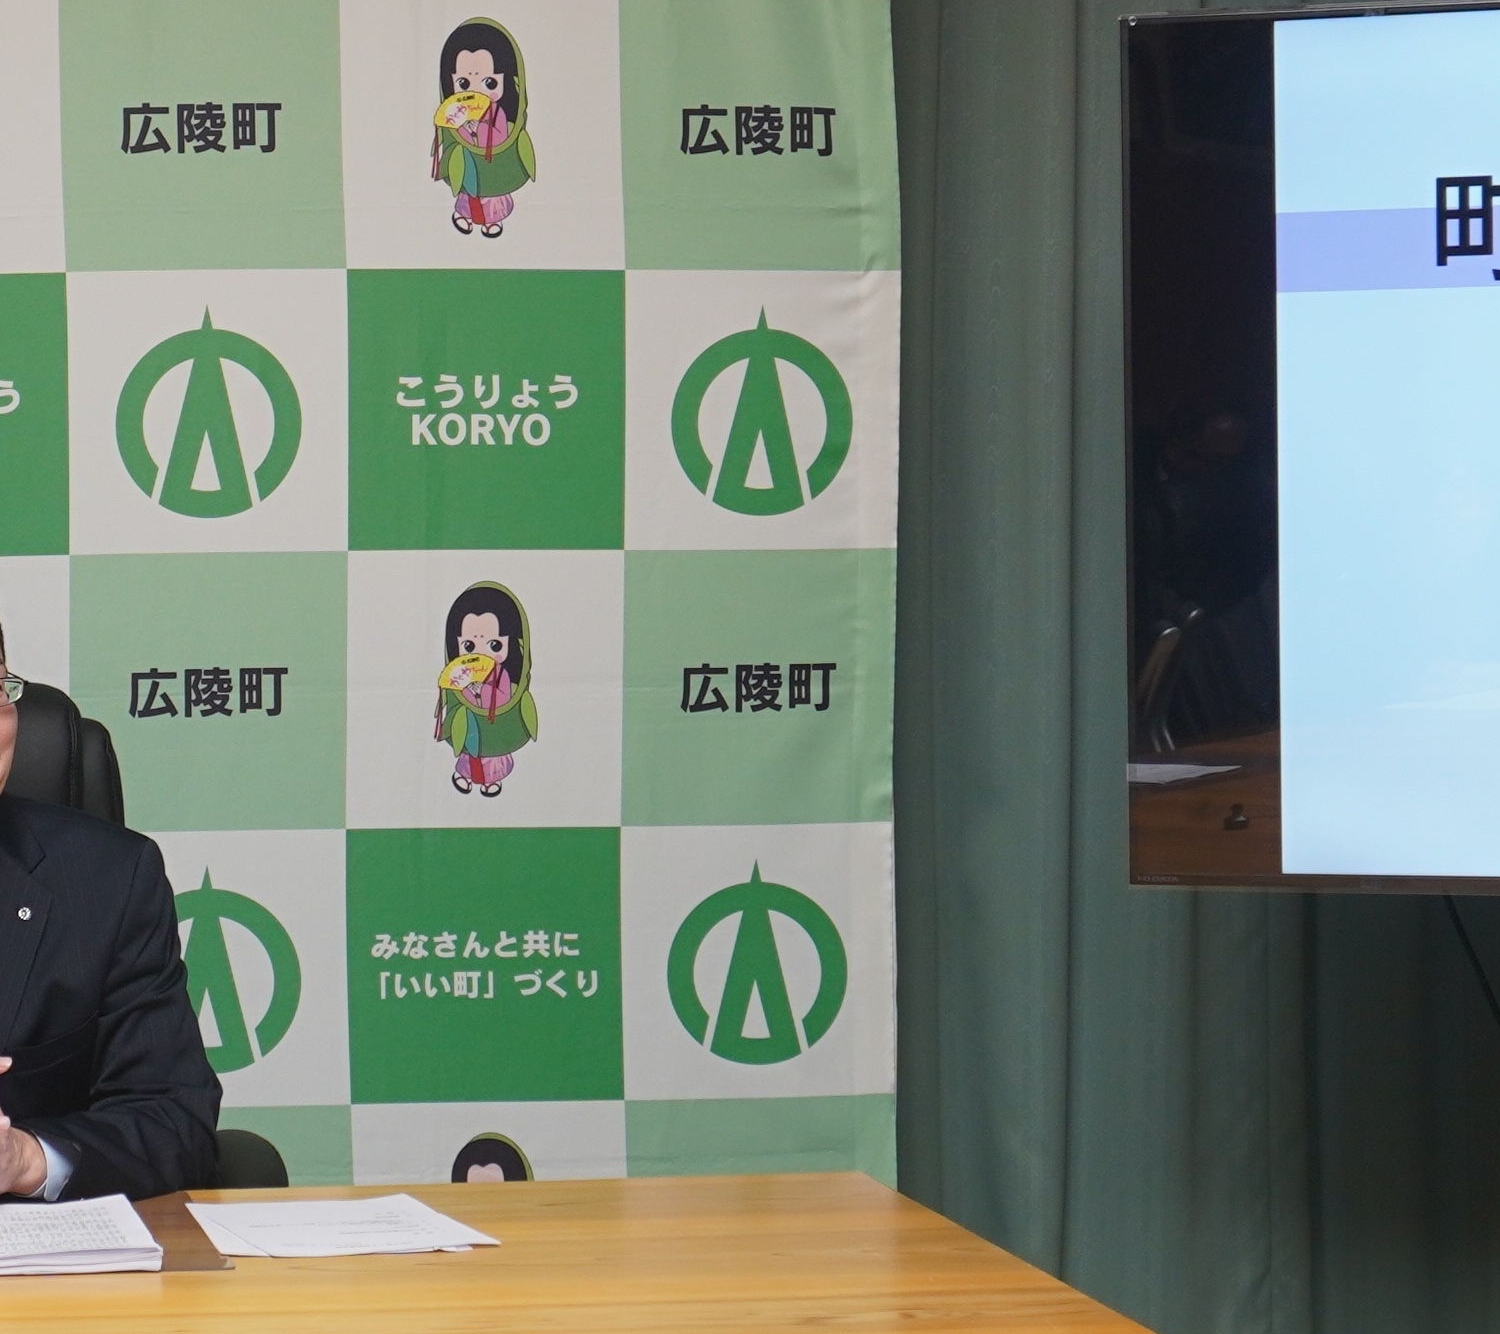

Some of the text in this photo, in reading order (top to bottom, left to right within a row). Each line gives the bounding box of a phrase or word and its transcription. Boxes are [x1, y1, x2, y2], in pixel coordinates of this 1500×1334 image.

[120, 101, 282, 154] 広陵町
[680, 103, 837, 157] 広陵町
[396, 373, 579, 410] こうりょう
[411, 412, 551, 447] KORYO
[128, 666, 289, 719] 広陵町
[680, 662, 837, 713] 広陵町
[370, 929, 580, 961] みなさんと共に
